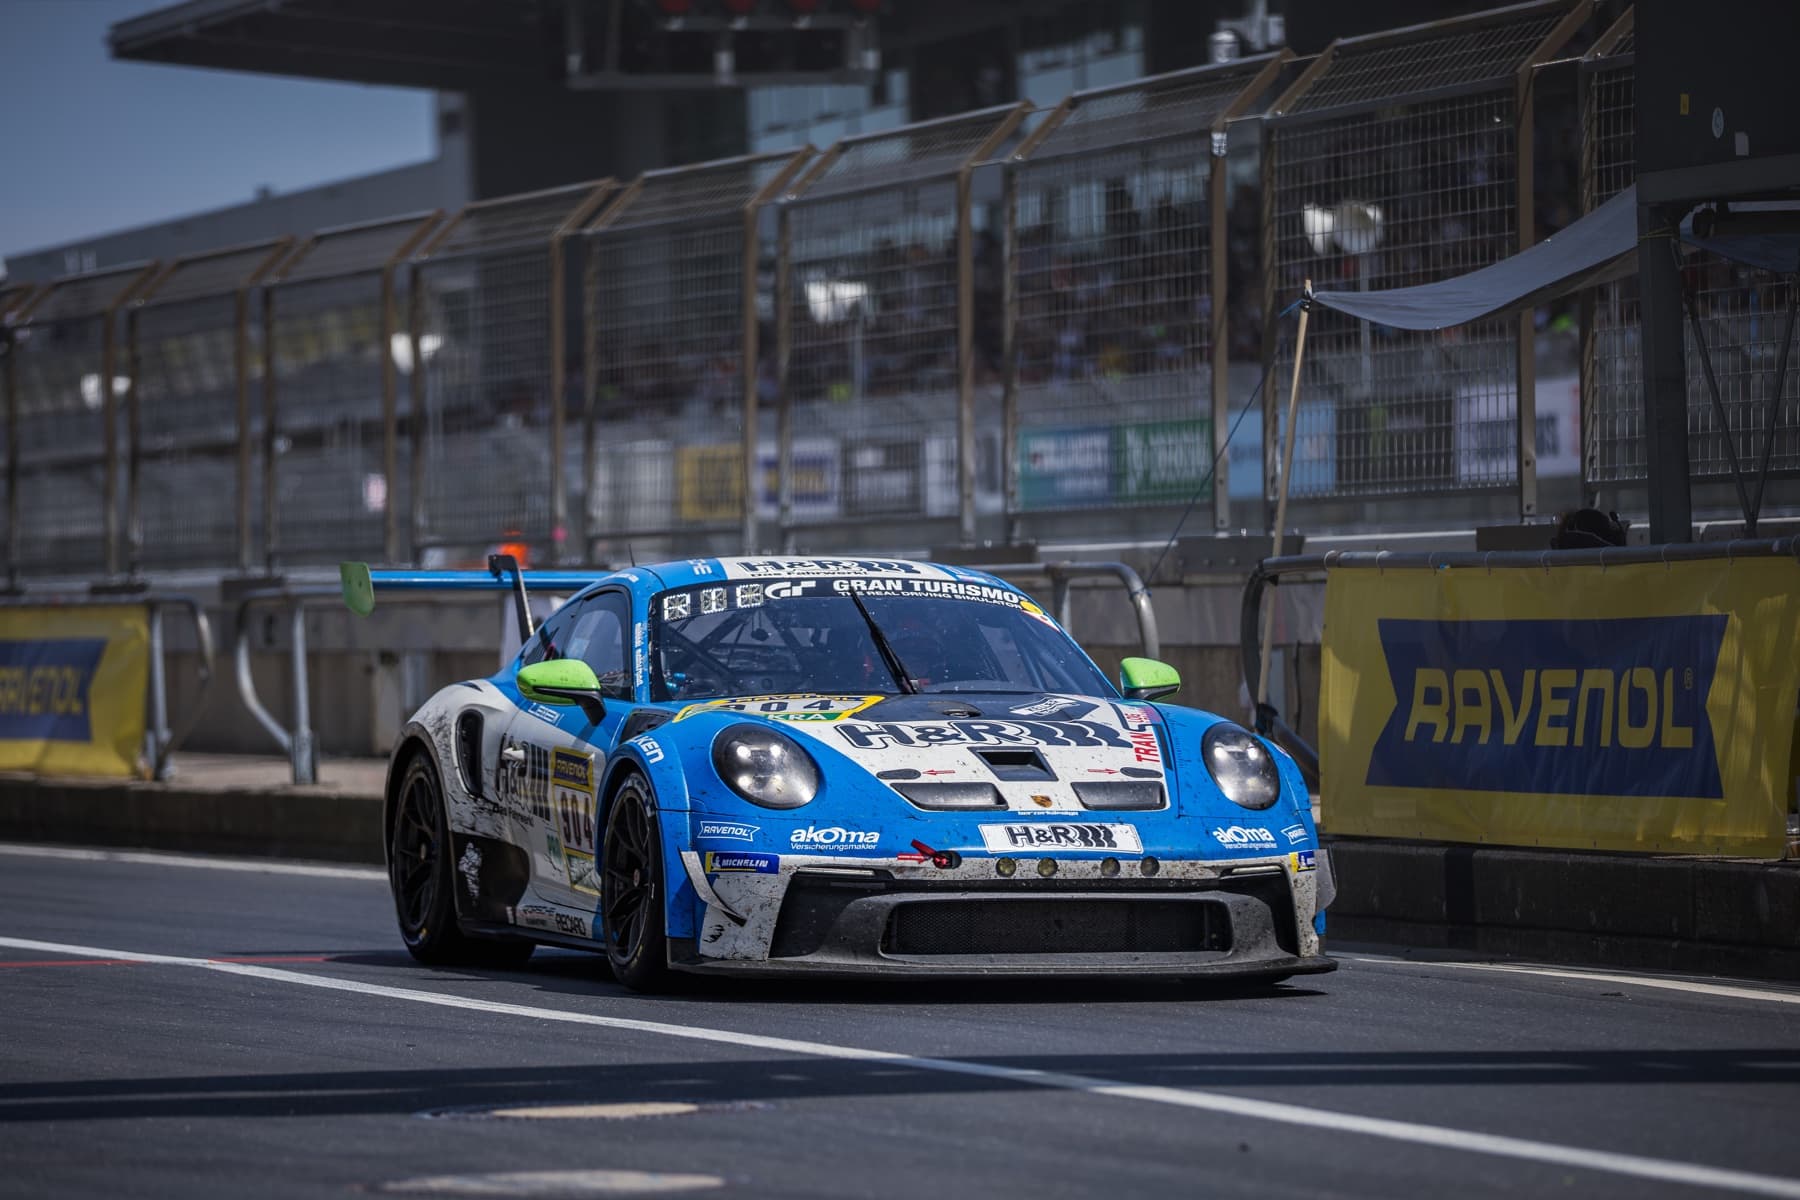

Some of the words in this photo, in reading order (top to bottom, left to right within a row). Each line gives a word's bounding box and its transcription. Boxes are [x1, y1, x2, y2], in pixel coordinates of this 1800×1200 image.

[833, 579, 903, 592] GRAN
[901, 591, 952, 599] DRIVING
[954, 594, 1023, 610] SIMULATOR
[561, 791, 594, 850] 904
[703, 825, 750, 837] RAVENOL
[790, 826, 880, 844] akoma
[790, 842, 878, 851] Versicherungsmakler
[721, 858, 769, 868] MICHELIN
[555, 912, 587, 937] RECARO
